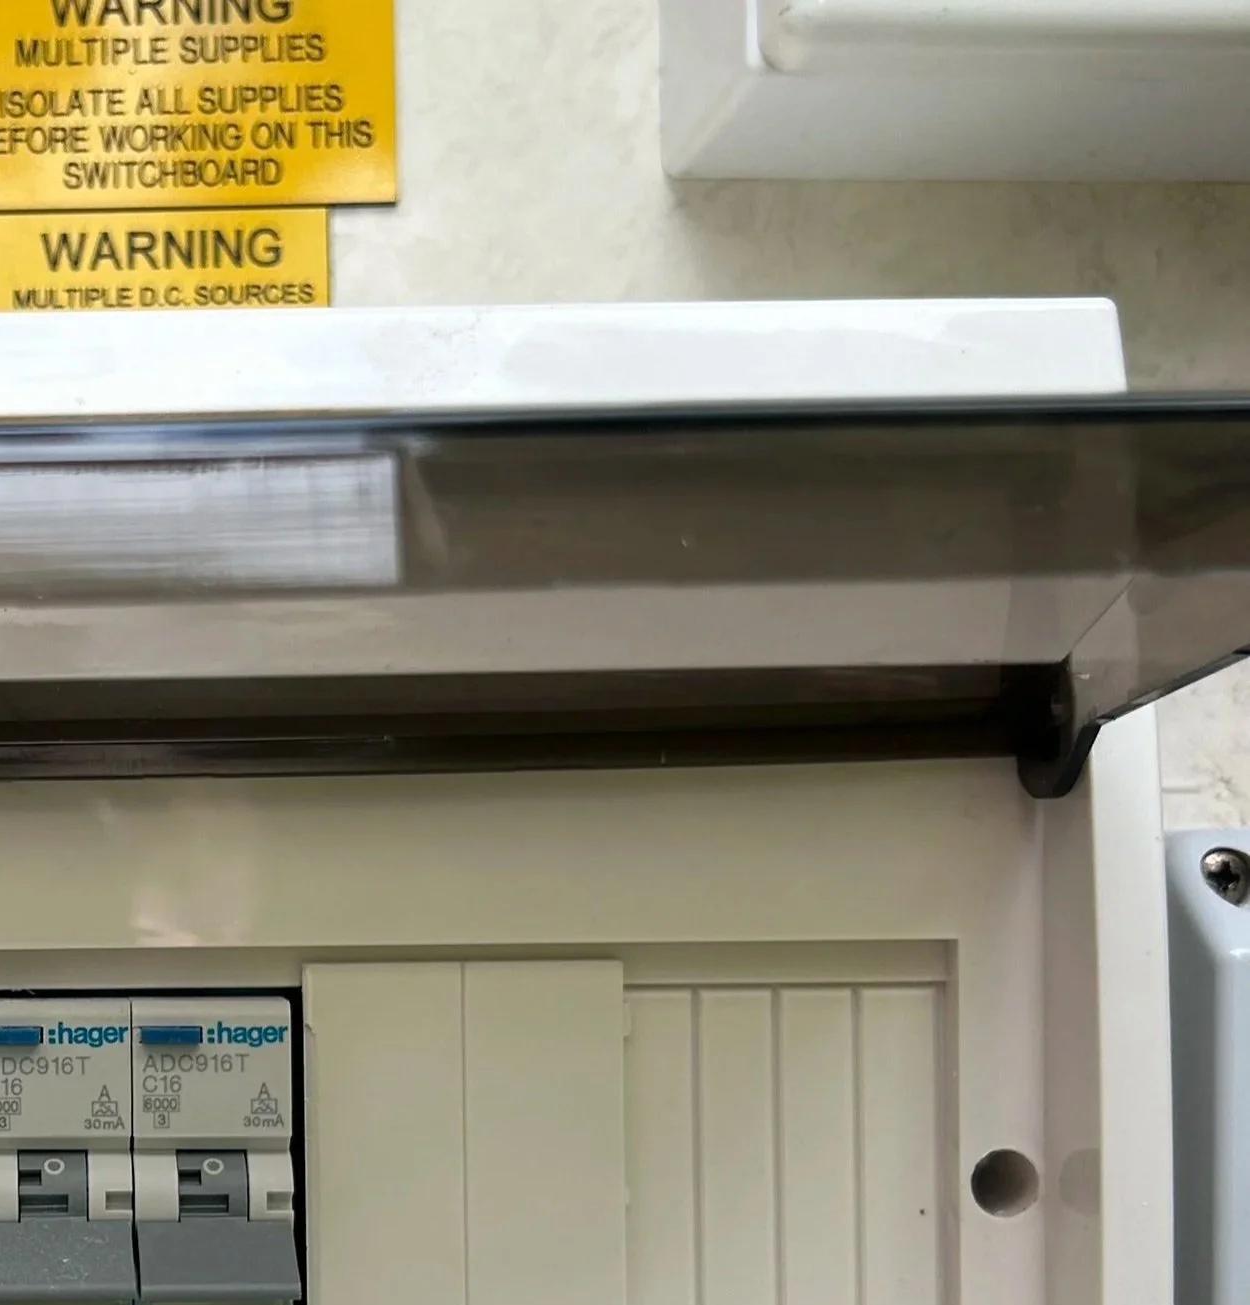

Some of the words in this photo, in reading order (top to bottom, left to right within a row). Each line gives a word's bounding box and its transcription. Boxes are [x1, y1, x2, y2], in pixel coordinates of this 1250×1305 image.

[14, 36, 169, 67] MULTIPLE
[179, 34, 327, 64] SUPPLIES
[0, 87, 125, 118] ISOLATE
[135, 87, 192, 116] ALL
[199, 84, 343, 114] SUPPLIES
[100, 121, 242, 154] WORKING
[252, 120, 296, 150] ON
[305, 119, 373, 149] THIS
[63, 158, 282, 190] SWITCHBOARD
[41, 228, 283, 272] WARNING
[13, 287, 133, 309] MULTIPLE
[140, 286, 188, 308] D.C.
[193, 284, 314, 307] SOURCES
[143, 1053, 250, 1073] ADC916T
[142, 1075, 182, 1093] C16
[143, 1098, 178, 1111] 6000
[84, 1118, 125, 1130] 30mA
[243, 1116, 284, 1128] 30mA
